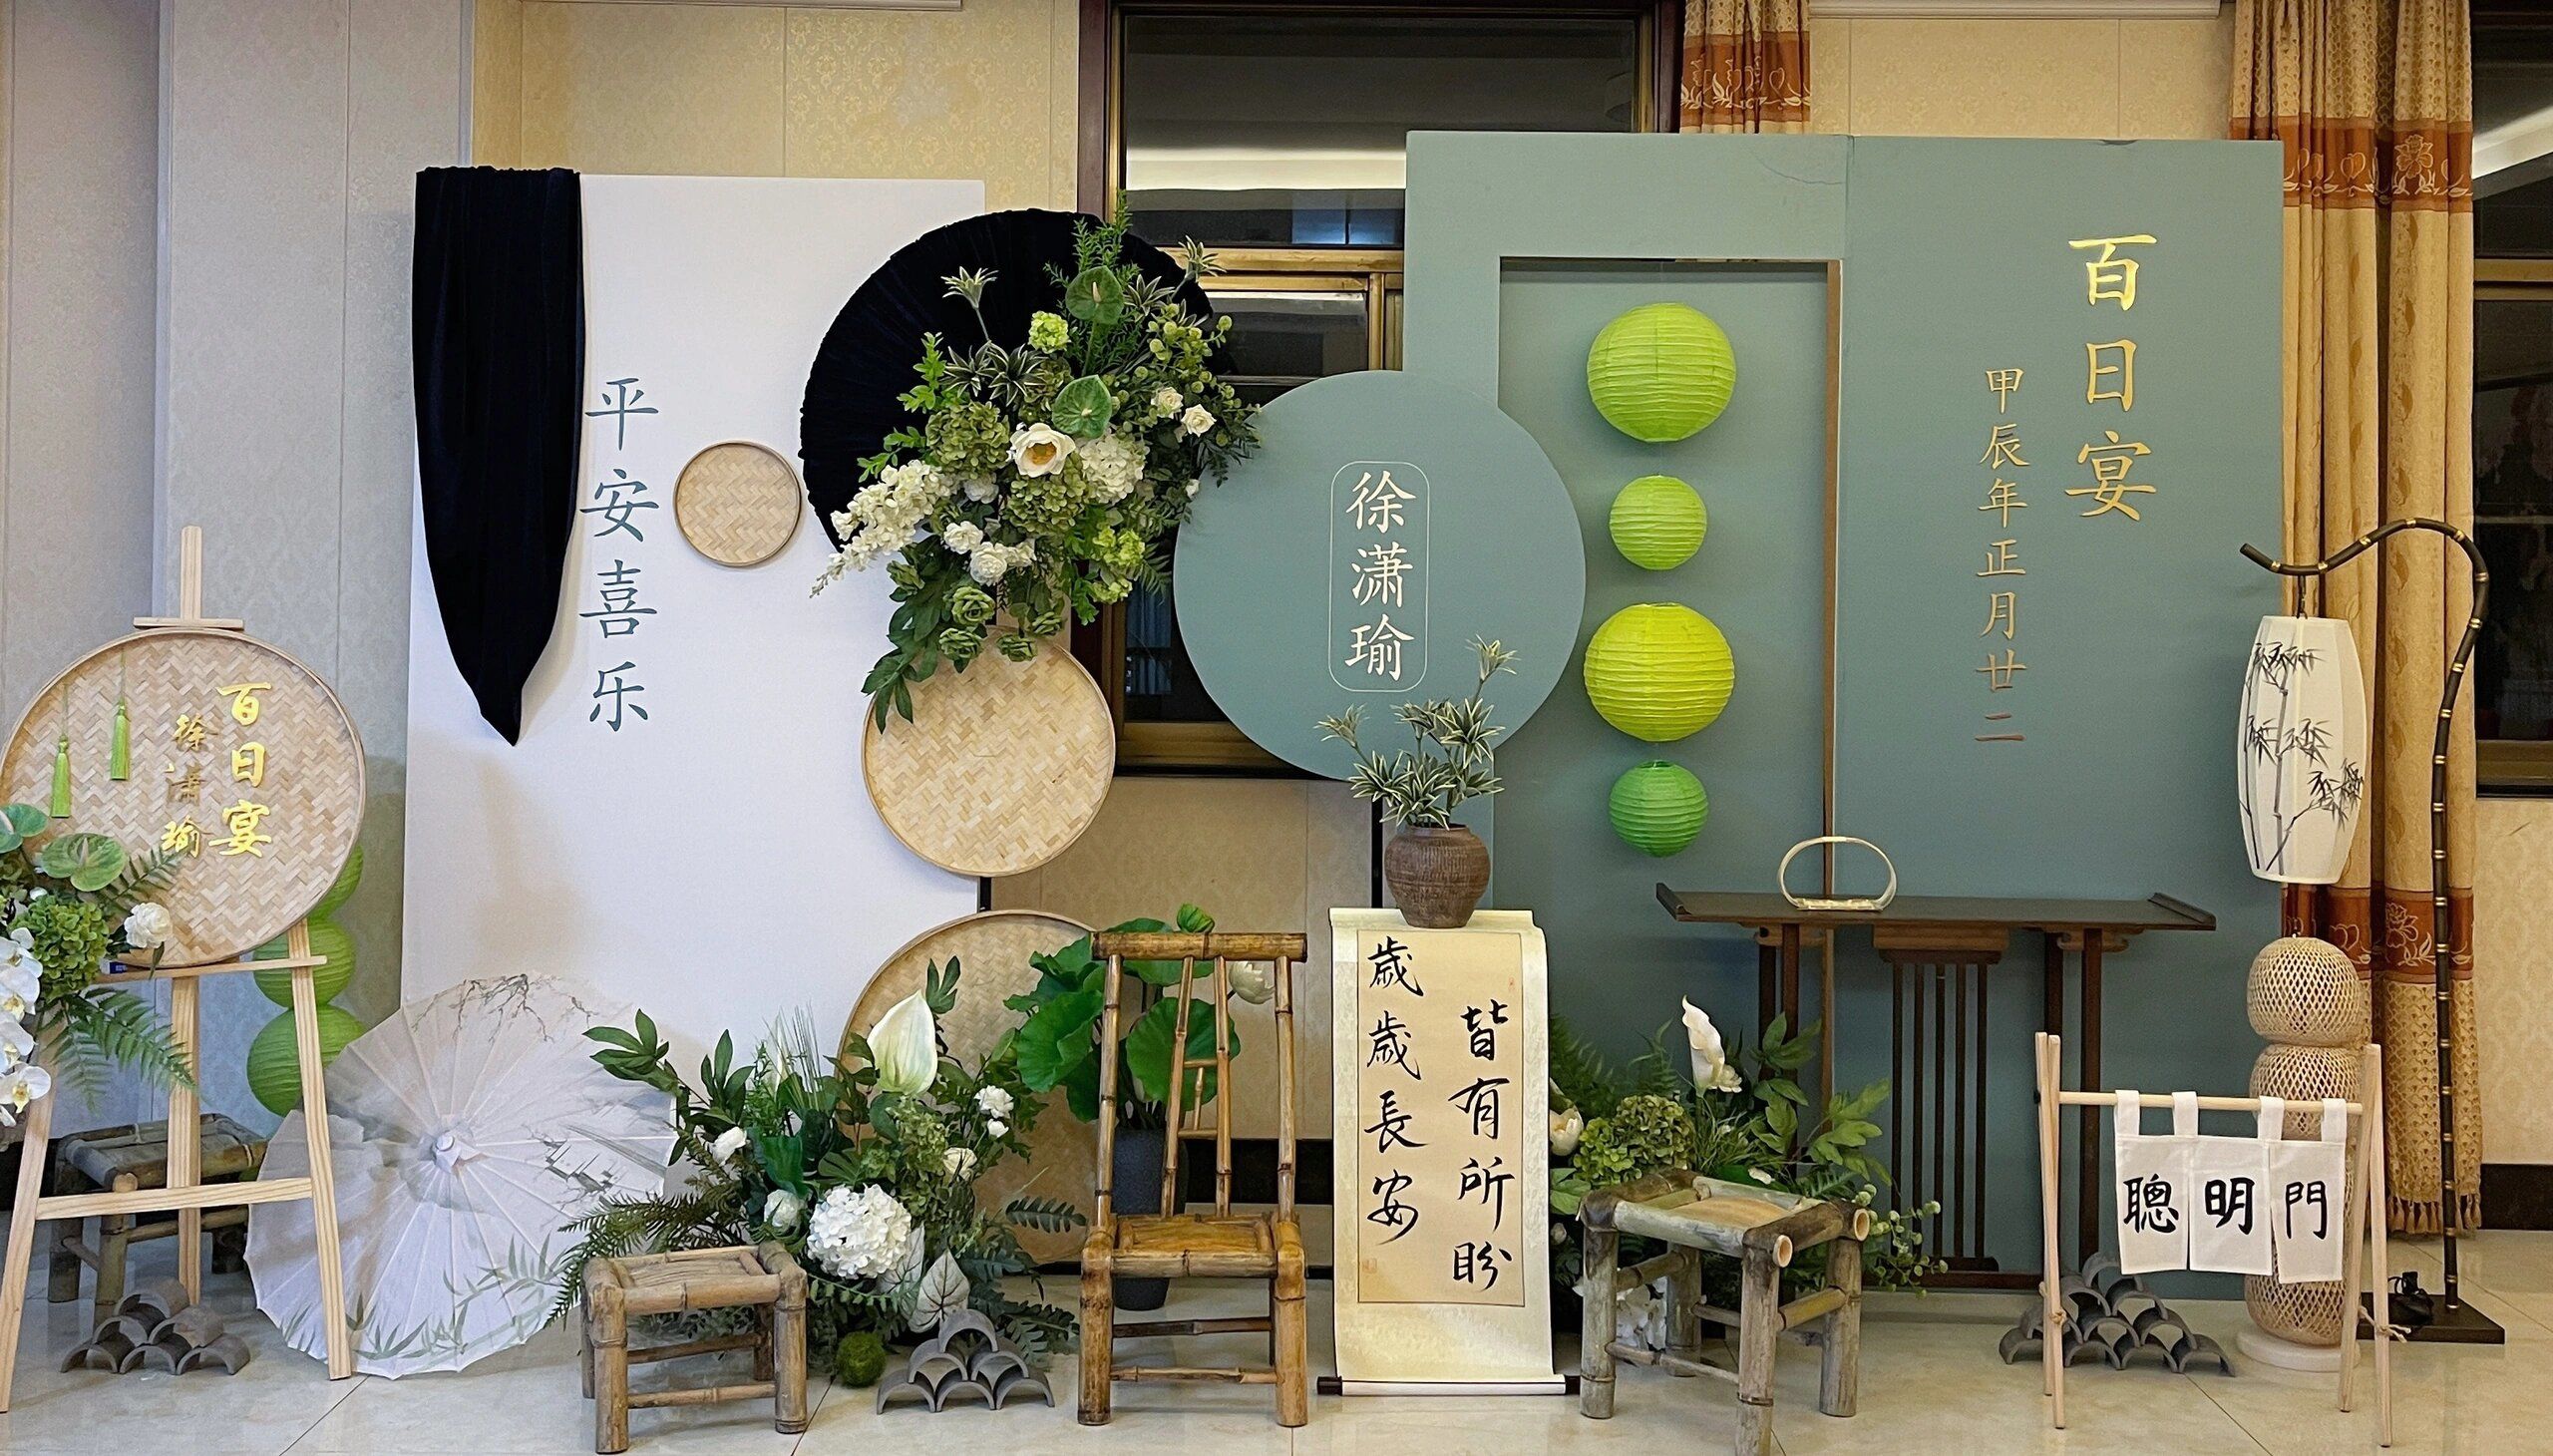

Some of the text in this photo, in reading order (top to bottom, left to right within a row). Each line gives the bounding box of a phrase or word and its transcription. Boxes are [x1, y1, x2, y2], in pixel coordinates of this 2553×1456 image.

[2064, 234, 2157, 522] 百日宴
[578, 377, 660, 733] 平安喜乐
[1344, 470, 1417, 682] 徐潇瑜
[1975, 368, 2030, 742] 甲辰年正月廿二
[208, 682, 272, 858] 百日宴
[1447, 999, 1516, 1293] 皆有所盼
